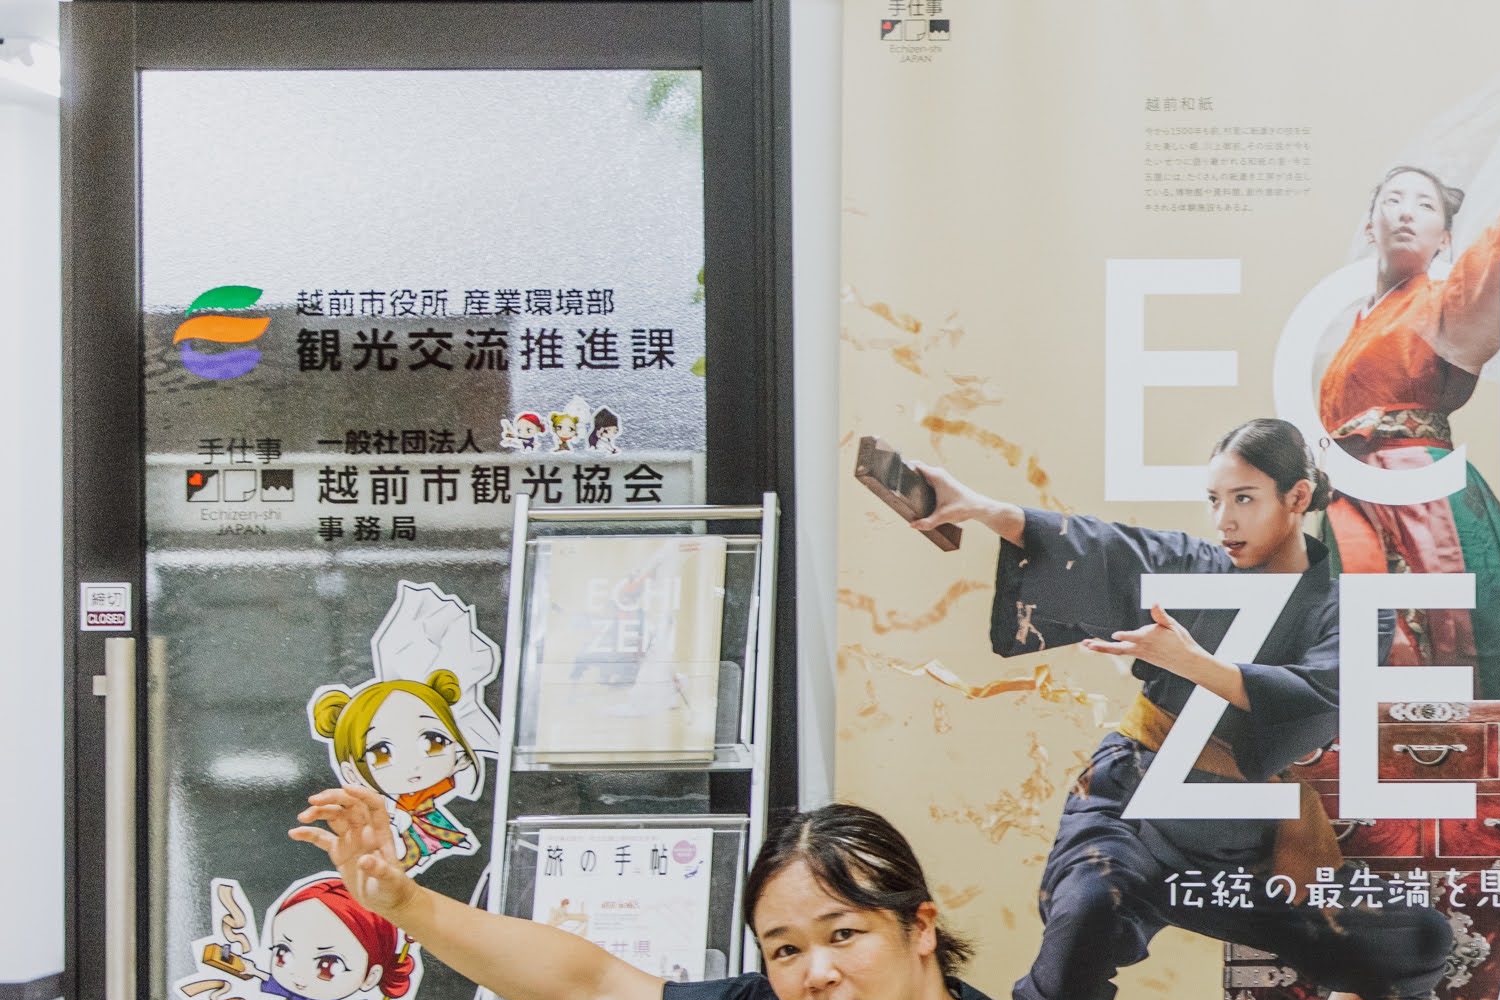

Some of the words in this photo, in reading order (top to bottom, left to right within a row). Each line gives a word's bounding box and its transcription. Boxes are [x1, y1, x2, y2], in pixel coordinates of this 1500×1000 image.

[1145, 97, 1213, 111] 越前和紙
[296, 289, 448, 317] 越前市役所
[462, 288, 615, 317] 産業環境部
[296, 327, 677, 373] 観光交流推進課
[197, 437, 283, 464] 手仕事
[317, 430, 483, 455] 一般社団法人
[317, 464, 665, 505] 越前市観光協会
[200, 506, 283, 522] Echizen-shi
[217, 524, 268, 537] JAPAN
[317, 516, 418, 541] 事務局
[87, 613, 125, 625] CLOSED
[544, 844, 669, 877] 旅の手帖
